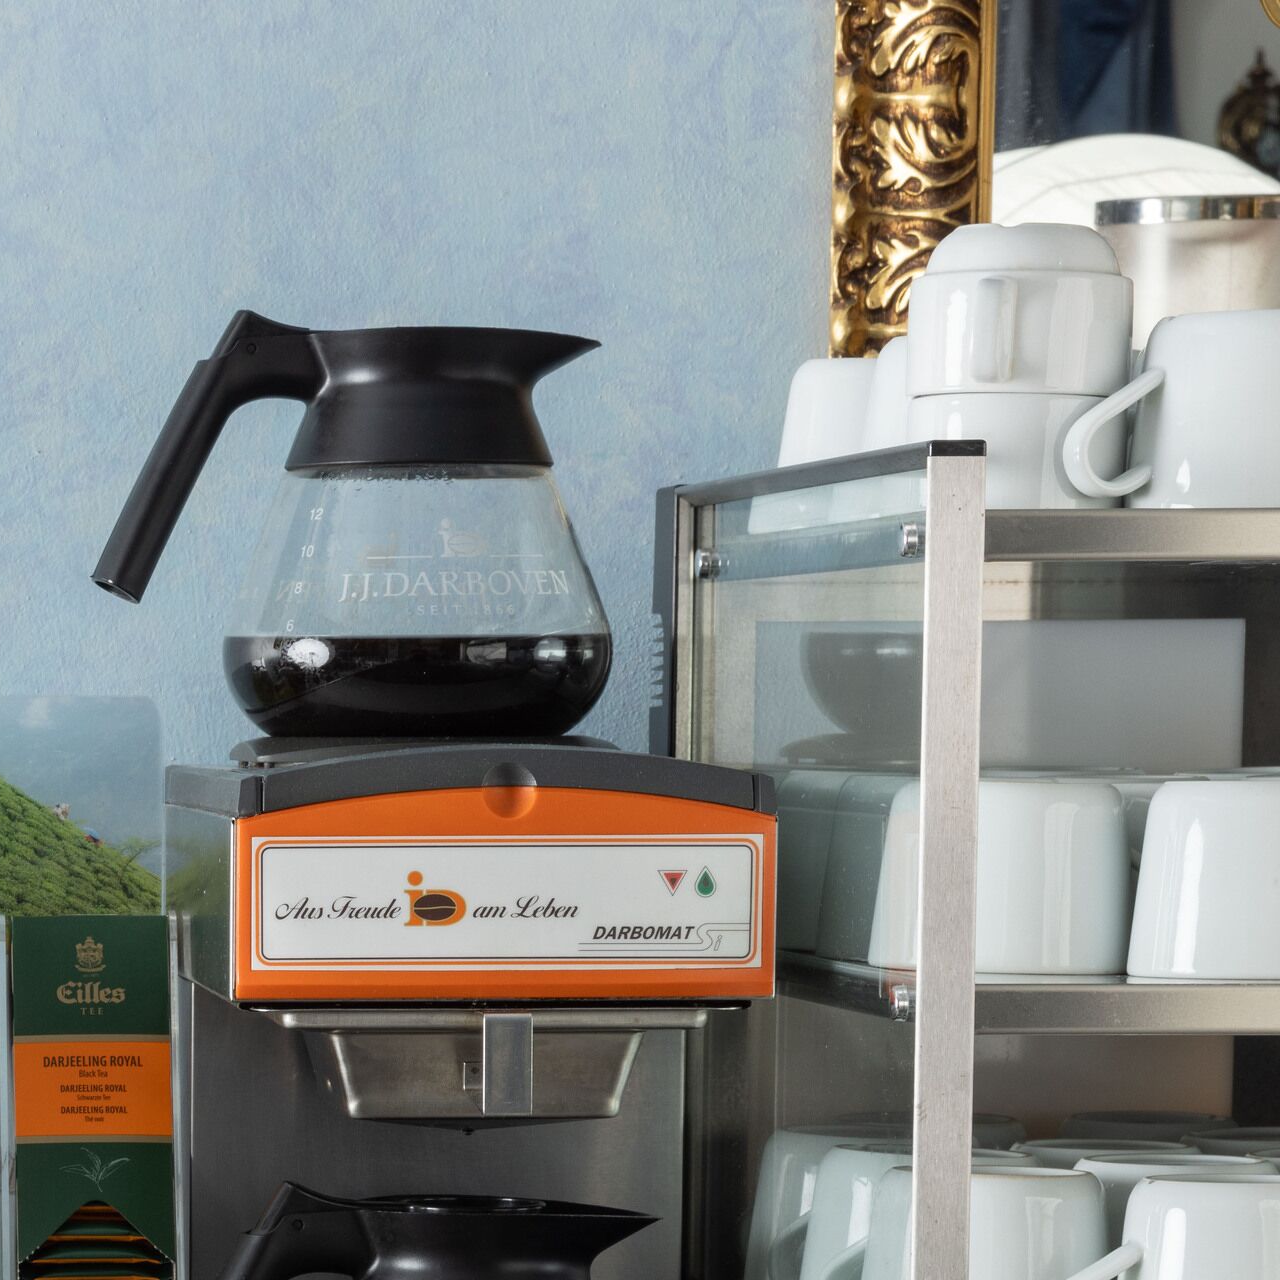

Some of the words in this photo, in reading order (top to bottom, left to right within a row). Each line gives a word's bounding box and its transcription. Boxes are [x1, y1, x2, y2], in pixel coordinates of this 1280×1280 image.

[309, 507, 324, 521] 12
[300, 544, 315, 558] 10
[293, 581, 303, 594] 8
[286, 619, 295, 632] 6
[274, 896, 324, 921] Aus
[472, 903, 506, 919] am
[510, 895, 579, 919] Leben
[592, 925, 695, 940] DARBOMAT
[56, 980, 127, 1005] Eilles
[80, 1007, 105, 1016] TEE
[43, 1055, 107, 1068] DARJEELING
[109, 1055, 144, 1068] ROYAL
[78, 1069, 96, 1078] Black
[97, 1070, 109, 1078] Tea
[60, 1084, 104, 1093] DARJEELING
[104, 1084, 128, 1093] ROYAL
[60, 1105, 104, 1115] DARJEELING
[105, 1105, 128, 1115] ROYAL
